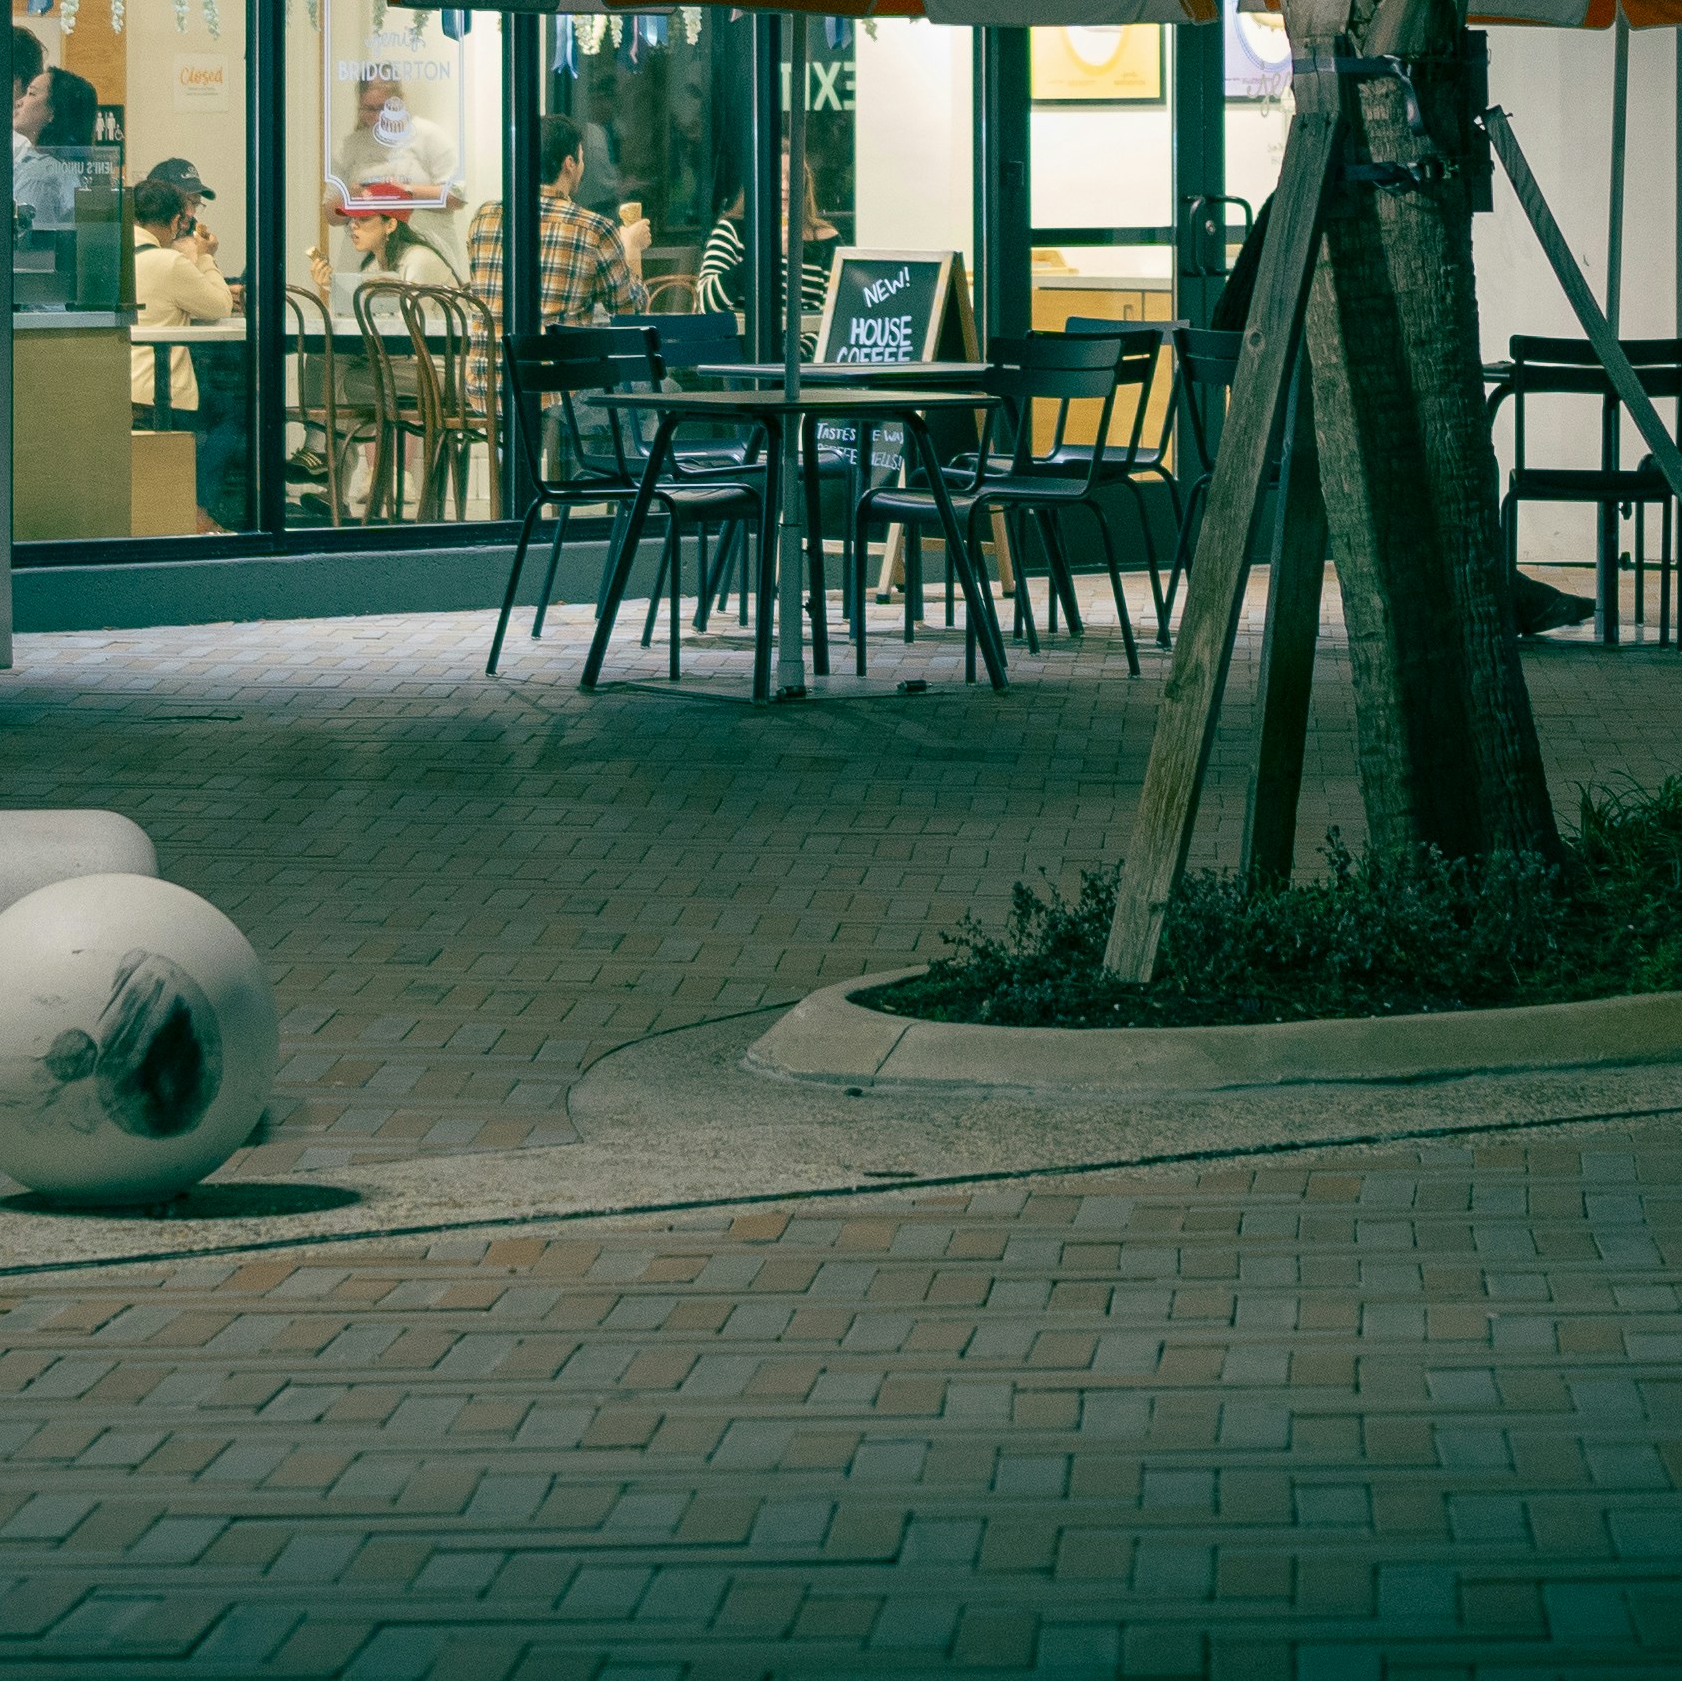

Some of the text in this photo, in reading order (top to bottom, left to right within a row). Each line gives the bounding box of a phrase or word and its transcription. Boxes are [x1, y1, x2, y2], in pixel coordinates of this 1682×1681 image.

[338, 60, 451, 82] BRIDGERTON
[863, 265, 911, 308] NEW!
[850, 315, 913, 347] HOUSE
[816, 422, 857, 441] TASTES
